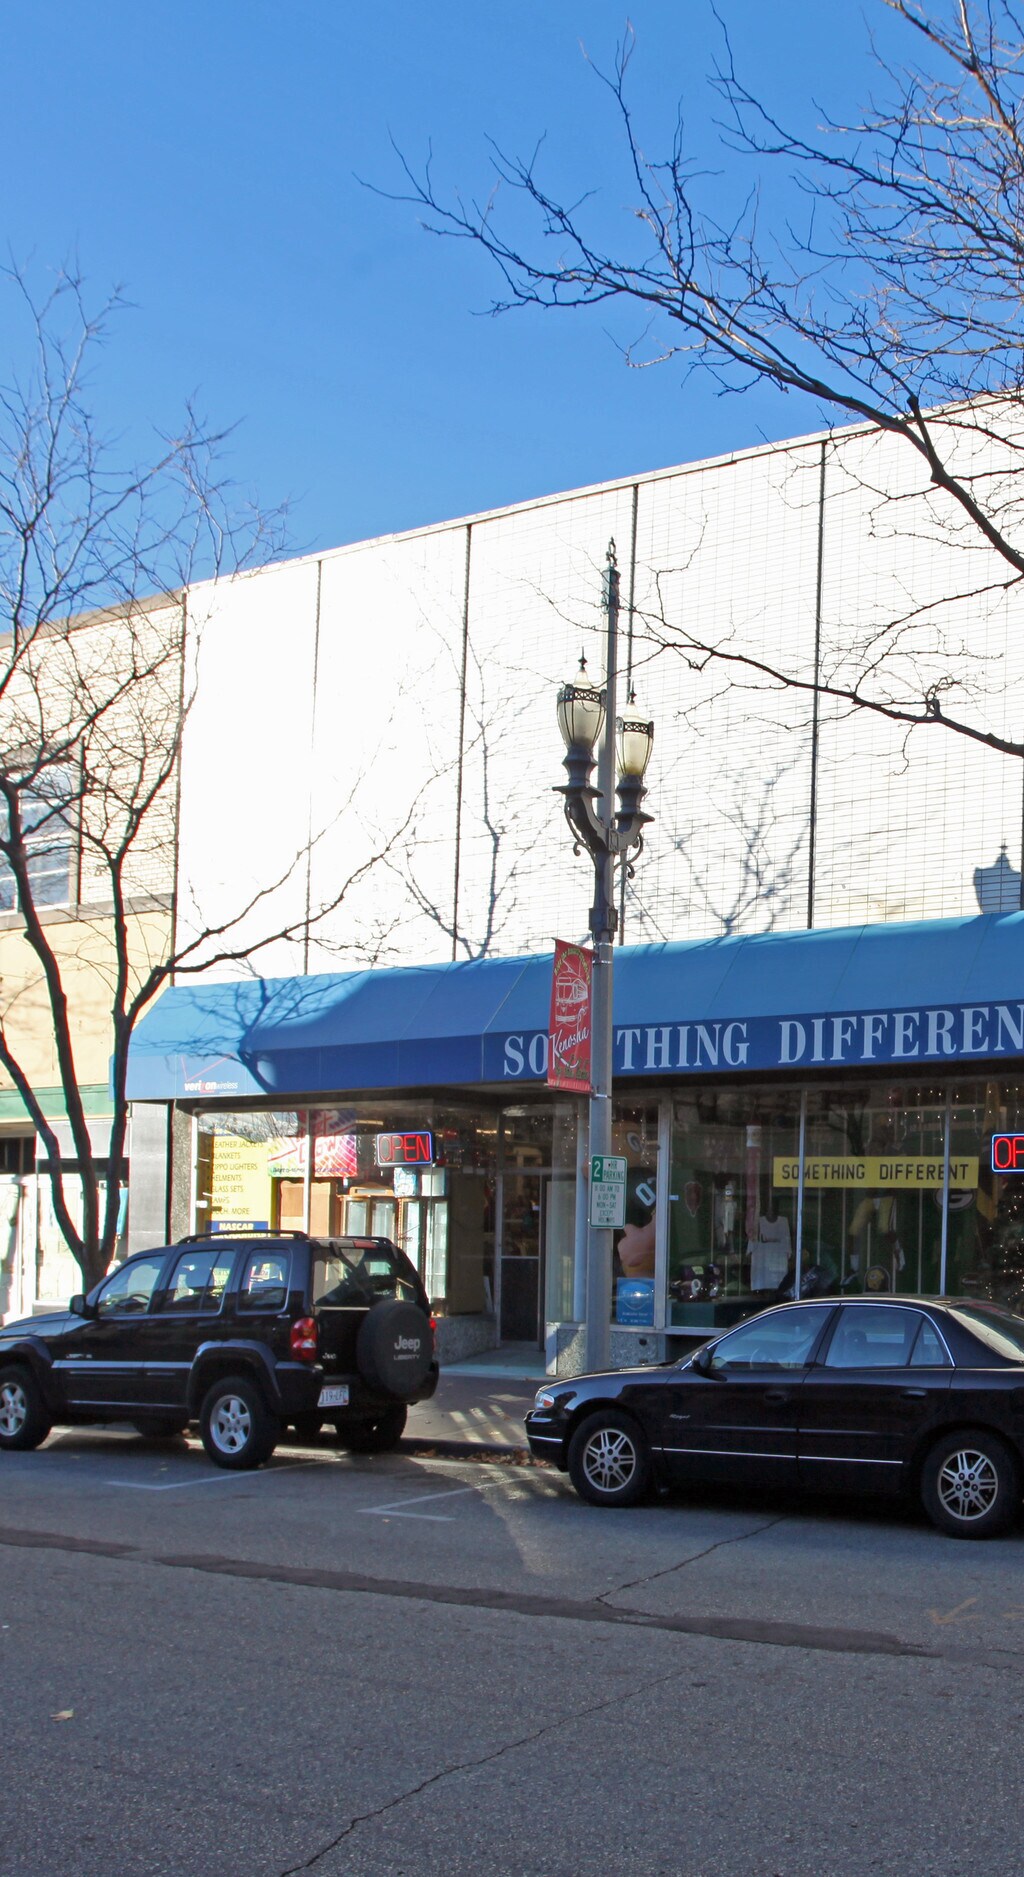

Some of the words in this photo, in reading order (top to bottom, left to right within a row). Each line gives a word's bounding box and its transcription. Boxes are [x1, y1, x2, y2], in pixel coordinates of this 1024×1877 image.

[504, 1022, 750, 1077] SOTHING
[549, 1027, 590, 1069] Kenosha
[380, 1134, 430, 1162] OPEN
[594, 1161, 601, 1177] 2
[610, 1161, 618, 1170] HR
[782, 1163, 865, 1180] SOMETHING
[879, 1163, 970, 1180] DIFFERENT
[603, 1170, 624, 1181] PARKING
[219, 1223, 255, 1231] NASCAR
[394, 1335, 420, 1352] Jeep
